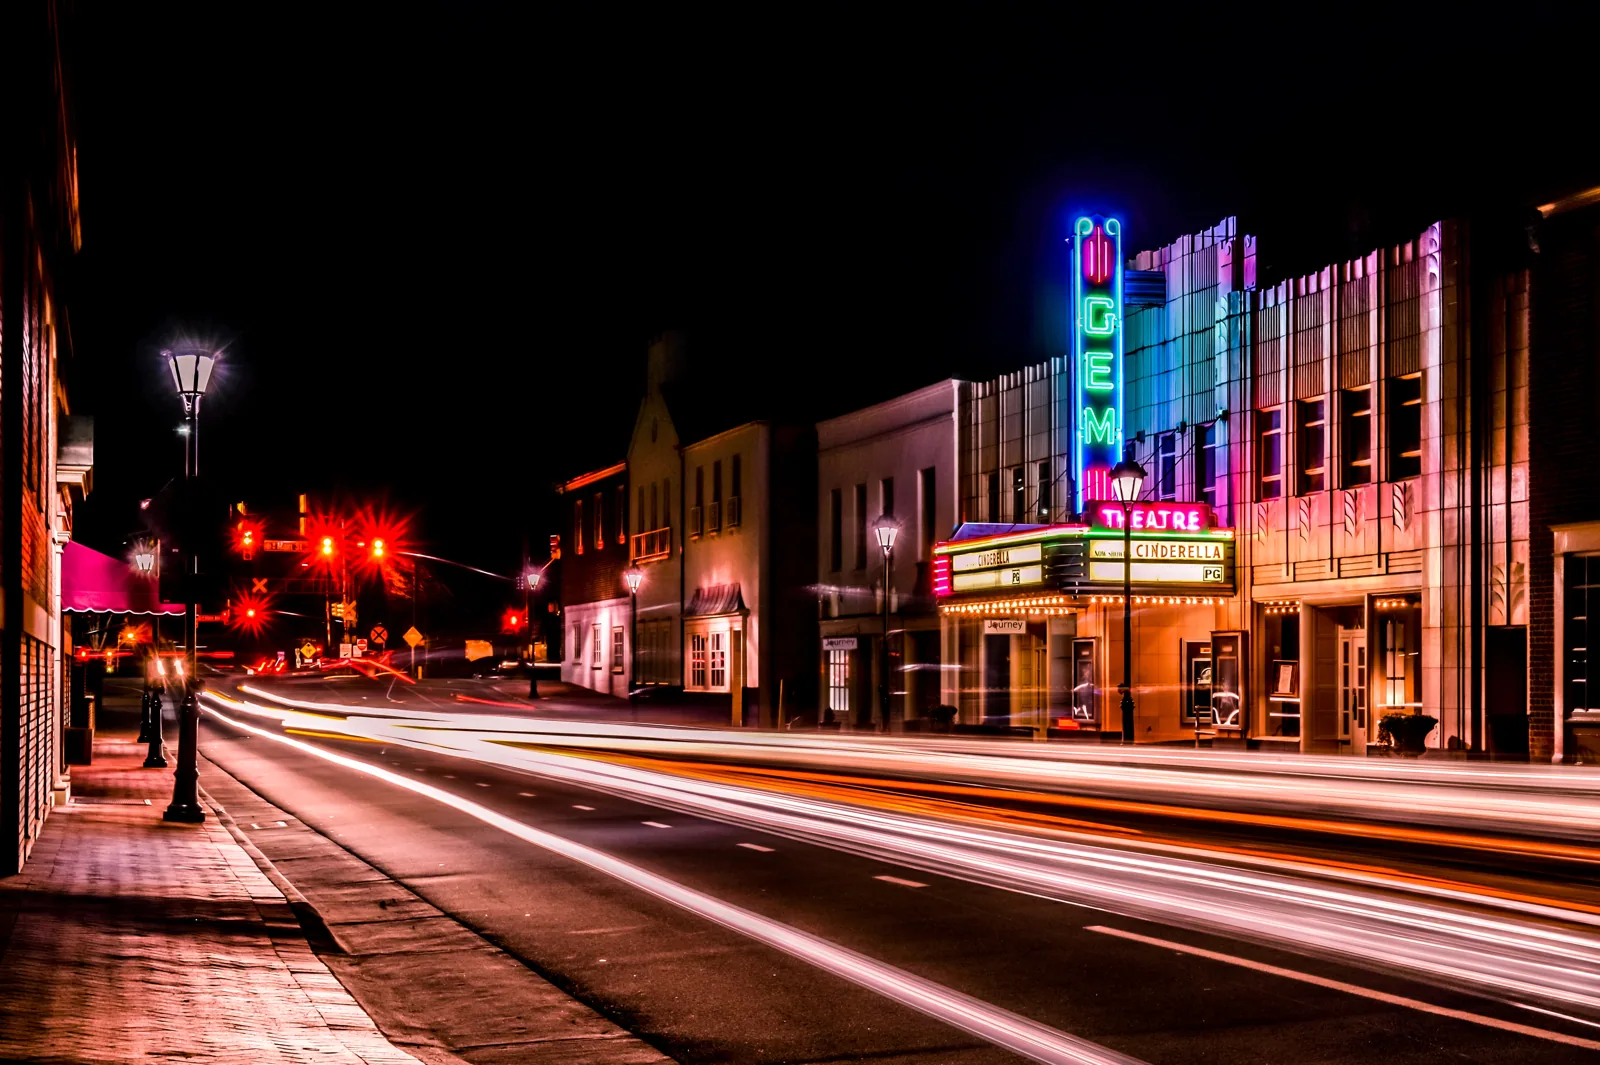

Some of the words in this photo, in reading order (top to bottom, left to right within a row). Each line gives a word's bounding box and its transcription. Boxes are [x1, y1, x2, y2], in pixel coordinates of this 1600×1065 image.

[1084, 296, 1116, 445] GEM
[1102, 509, 1201, 531] THEATRE
[1136, 543, 1222, 559] CINDERELLA
[978, 550, 1010, 567] CINDERELLA
[1012, 571, 1020, 582] PG
[1204, 568, 1221, 580] PG
[988, 619, 1023, 631] Journey
[826, 638, 855, 647] Journey
